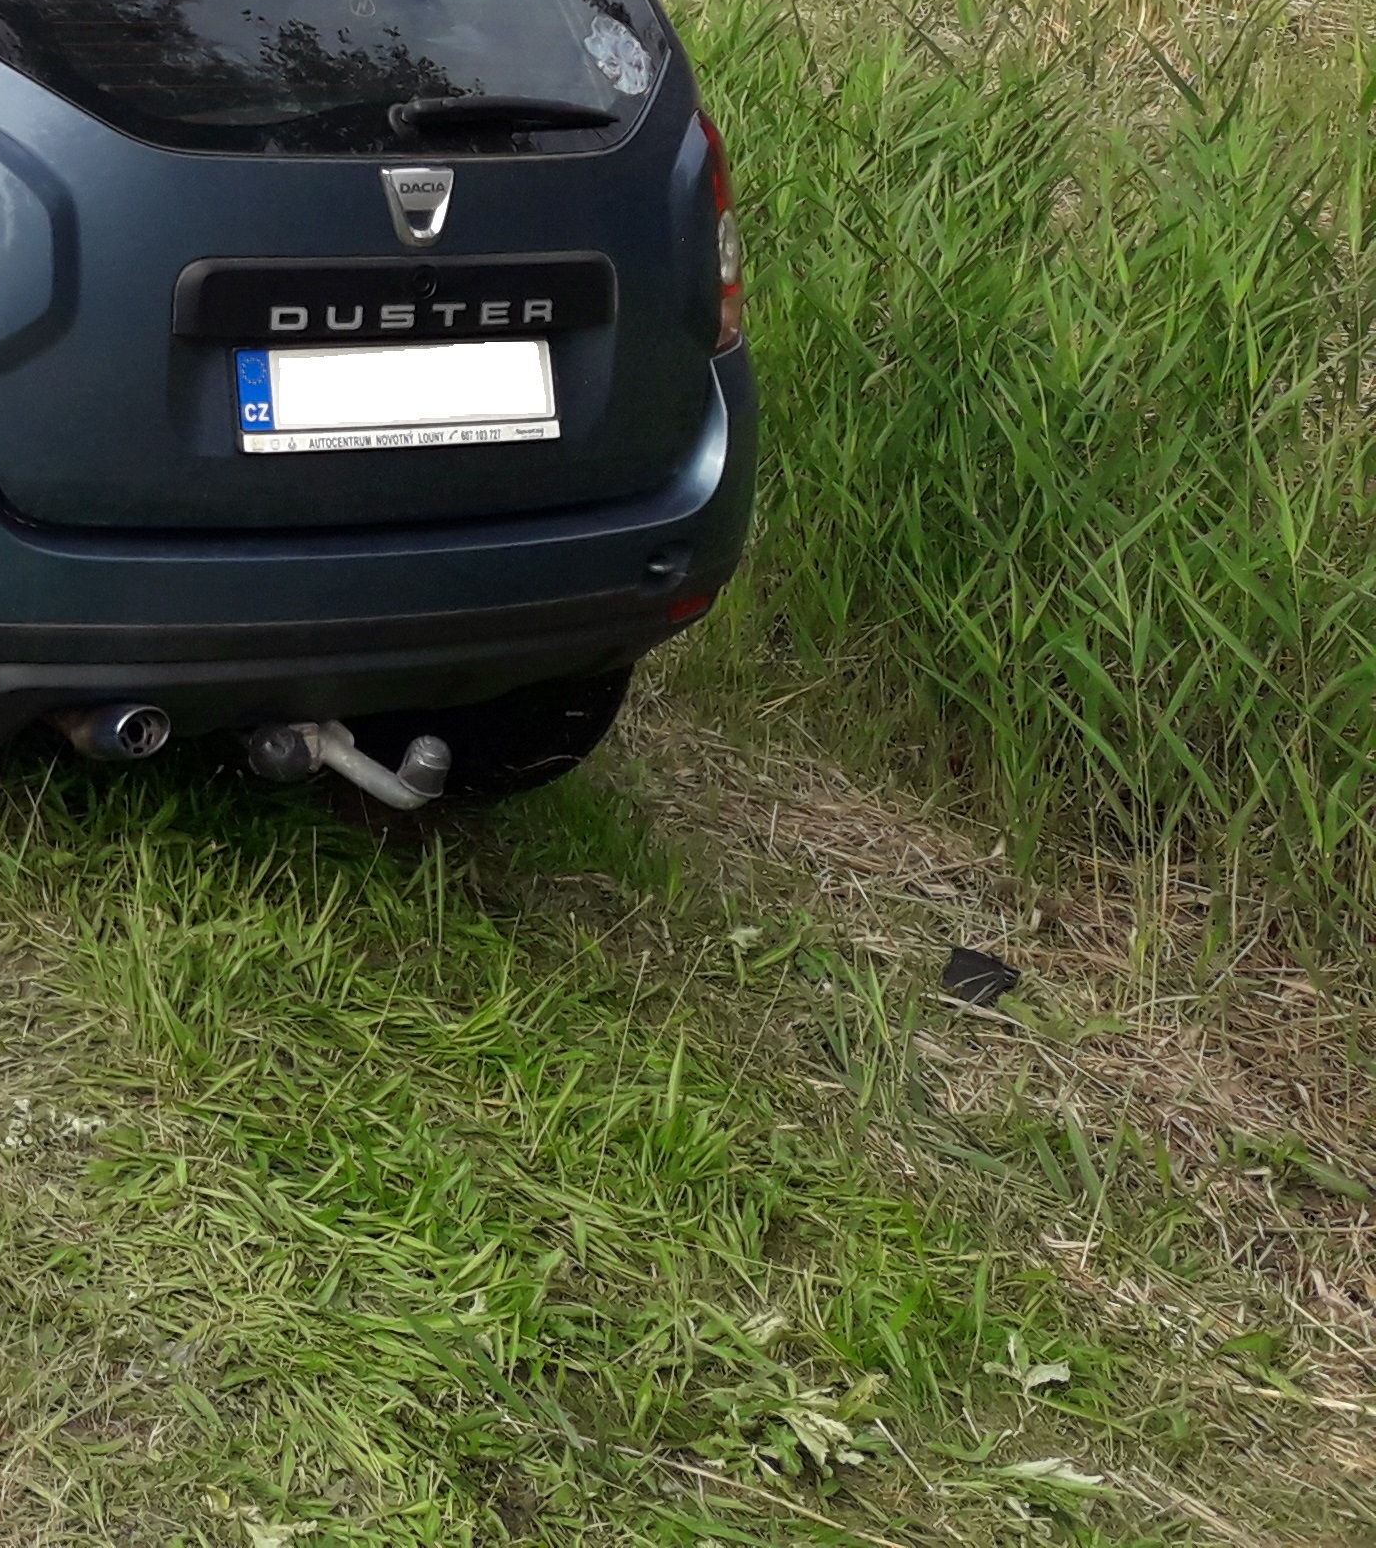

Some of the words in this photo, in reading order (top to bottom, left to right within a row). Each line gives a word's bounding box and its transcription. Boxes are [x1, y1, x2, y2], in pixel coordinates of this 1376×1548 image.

[399, 181, 445, 194] DACIA
[269, 299, 553, 331] DUSTER
[244, 403, 270, 422] CZ
[309, 435, 372, 449] AUTOCENTRUM
[418, 431, 444, 444] LOUNY
